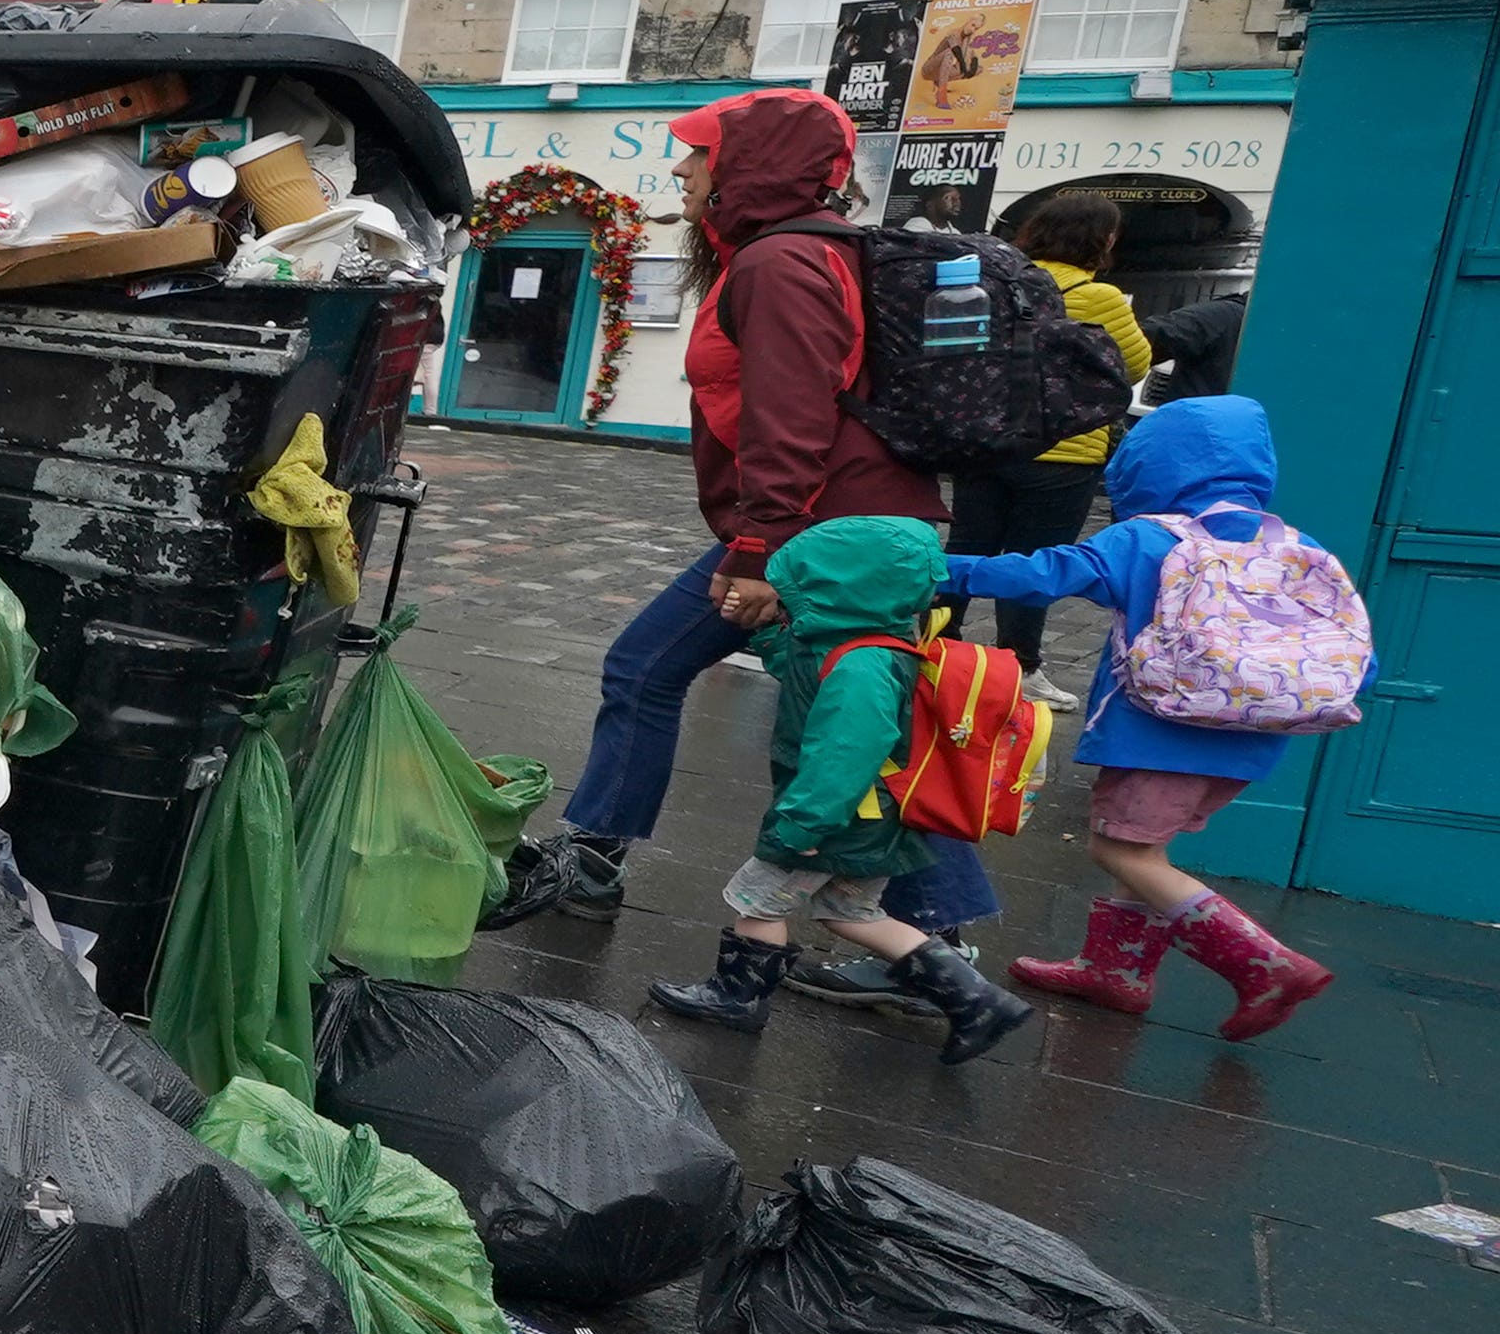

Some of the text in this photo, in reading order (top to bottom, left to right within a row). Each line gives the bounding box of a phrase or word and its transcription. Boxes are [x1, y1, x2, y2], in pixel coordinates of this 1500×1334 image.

[849, 65, 886, 82] BEN
[839, 81, 888, 101] HART
[35, 100, 116, 136] HOLD BOX FLAT
[537, 132, 571, 159] &
[896, 141, 1003, 169] AURIE STYLA
[1016, 140, 1262, 169] 0131 225 5028
[909, 168, 979, 186] GREEN
[1160, 188, 1199, 200] CLOSE
